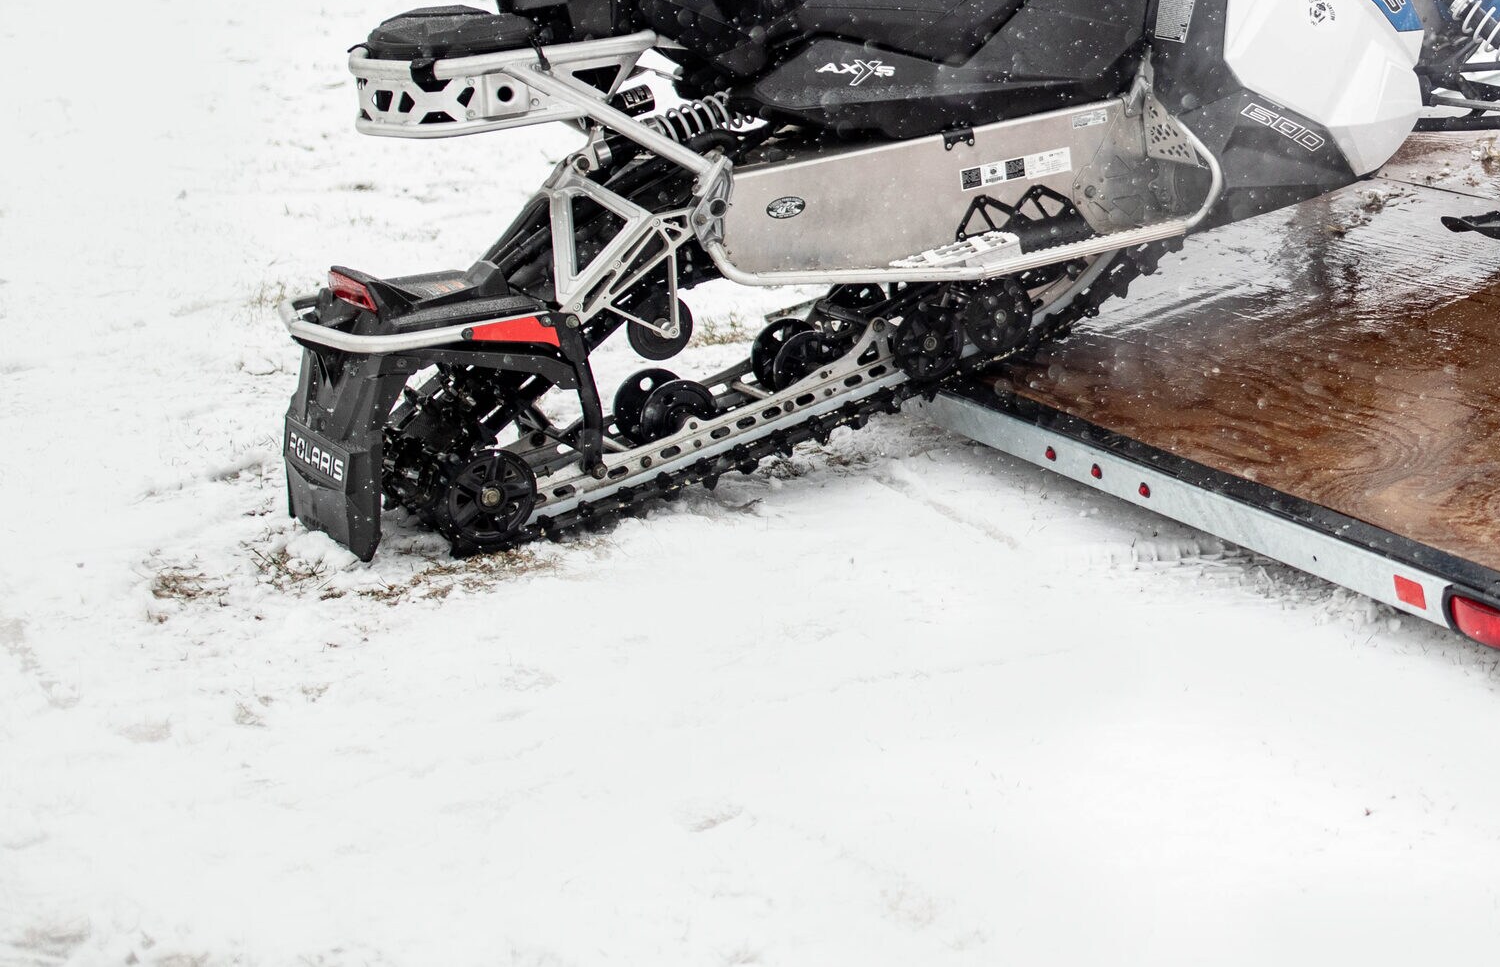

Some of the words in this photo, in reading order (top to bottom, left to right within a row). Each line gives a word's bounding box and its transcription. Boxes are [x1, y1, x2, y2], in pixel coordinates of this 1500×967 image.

[815, 59, 895, 86] AXYS
[1240, 102, 1325, 151] 600
[289, 432, 344, 482] POLARIS
